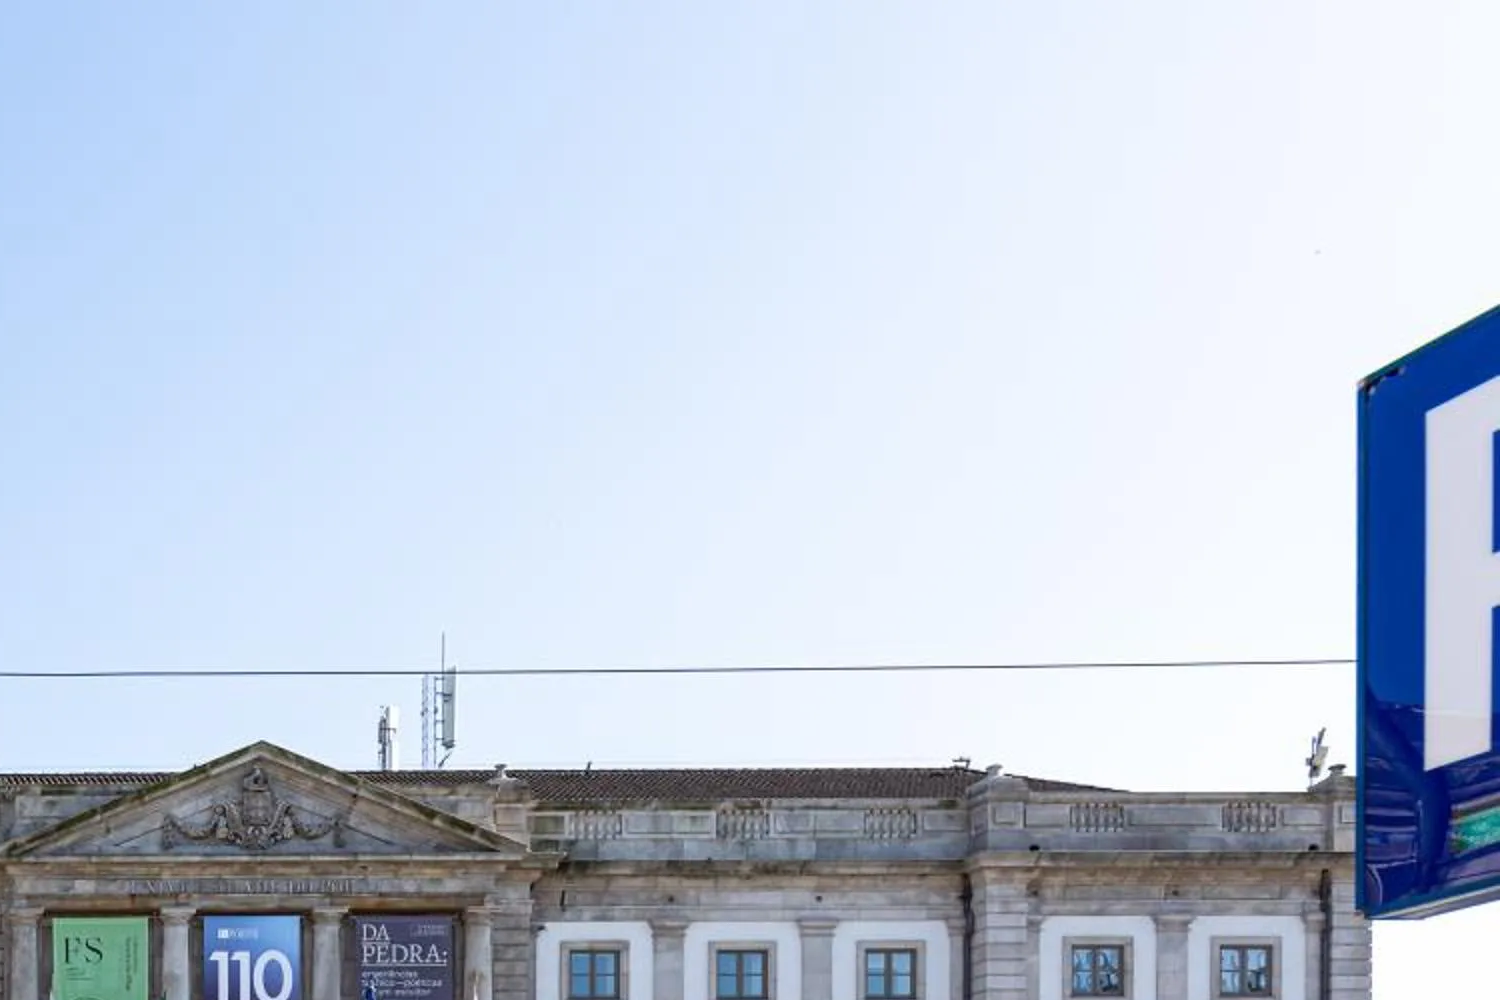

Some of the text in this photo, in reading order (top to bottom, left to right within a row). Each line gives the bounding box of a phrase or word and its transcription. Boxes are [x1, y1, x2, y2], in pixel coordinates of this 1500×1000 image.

[362, 923, 389, 941] DA
[64, 936, 104, 965] FS
[362, 943, 448, 964] PEDRA:
